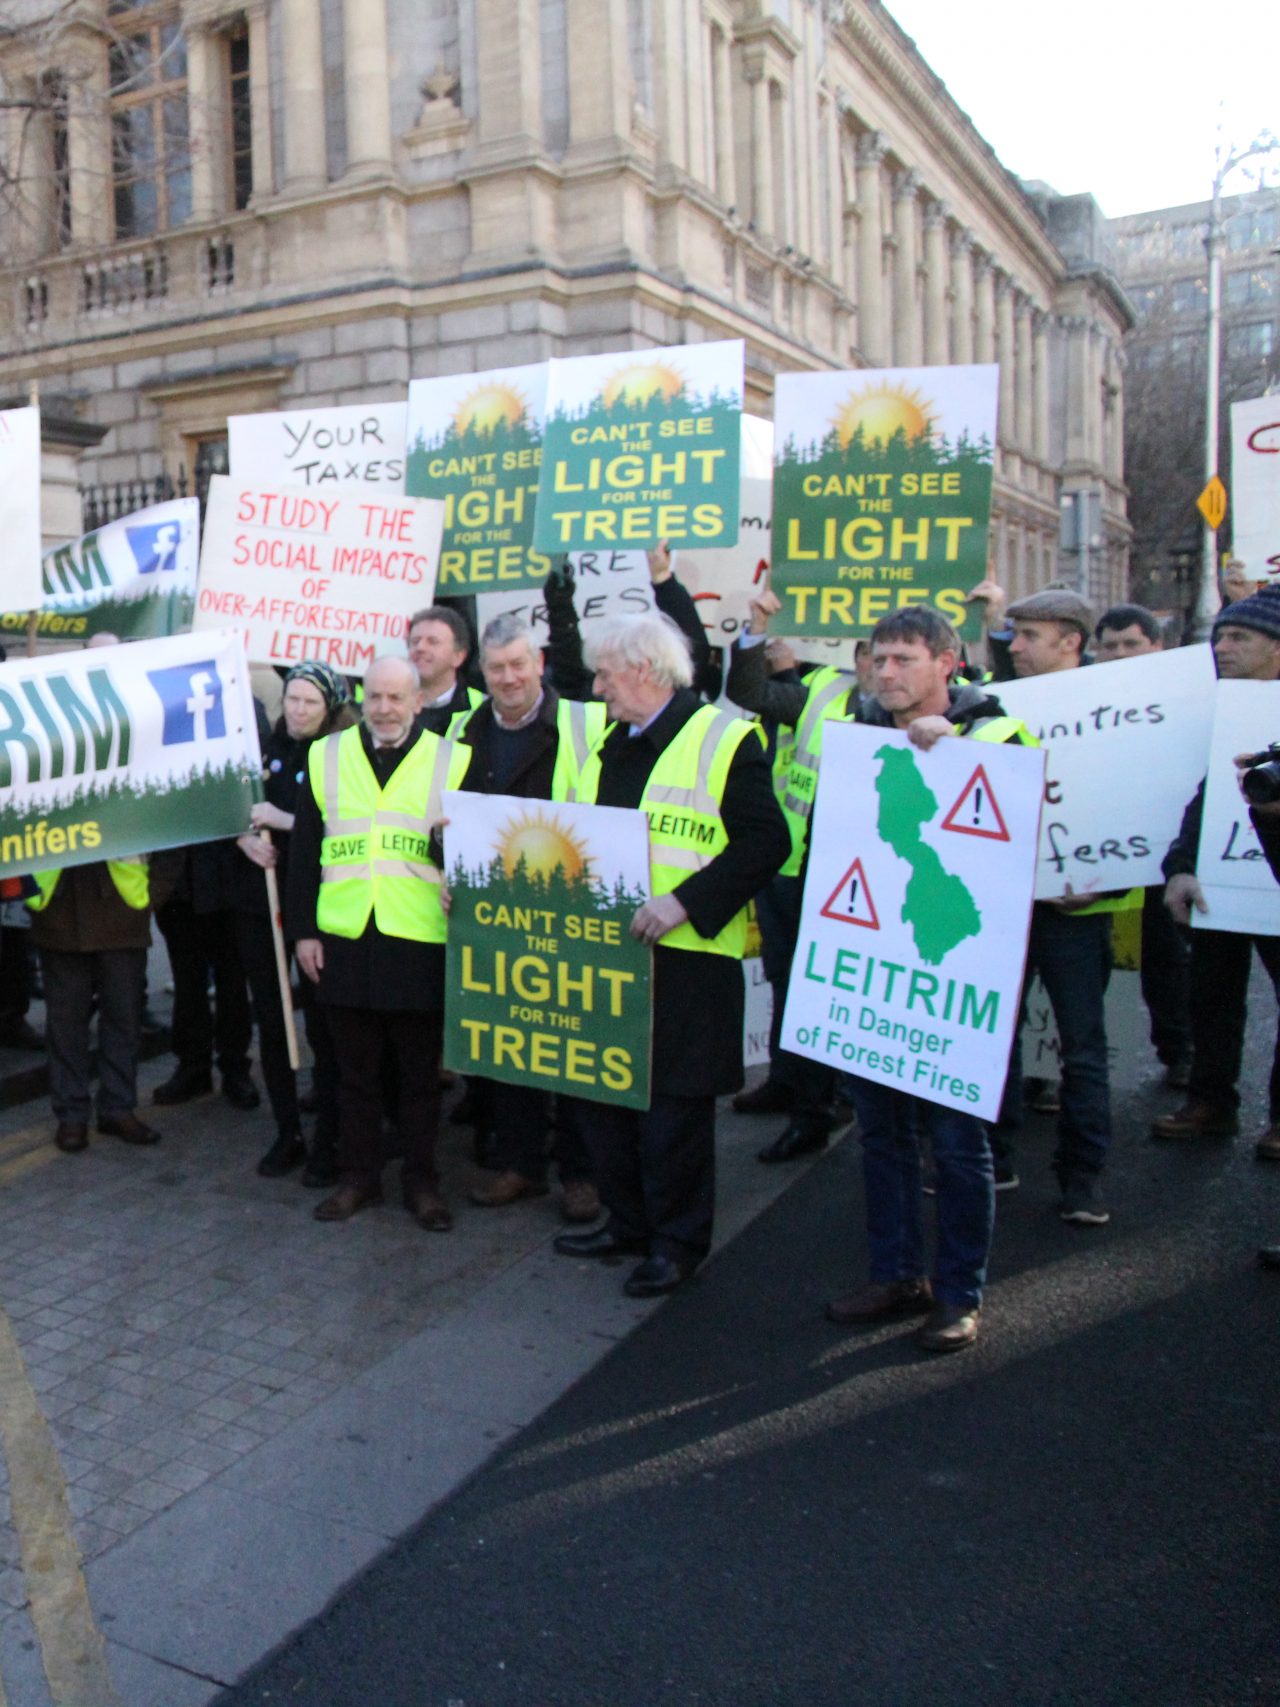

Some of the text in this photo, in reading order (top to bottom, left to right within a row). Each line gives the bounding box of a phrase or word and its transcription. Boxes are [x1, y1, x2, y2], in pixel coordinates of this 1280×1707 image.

[282, 416, 385, 459] YOUR
[570, 416, 715, 445] CAN'T SEE
[622, 440, 653, 452] THE
[291, 459, 403, 487] TAXES
[428, 447, 544, 479] CAN'T SEE
[471, 473, 498, 487] THE
[553, 448, 727, 494] LIGHT
[601, 489, 673, 504] FOR THE
[801, 472, 962, 498] CAN'T SEE
[237, 491, 416, 543] STUDY THE
[443, 485, 541, 530] IGH
[551, 503, 725, 543] TREES
[857, 498, 893, 513] THE
[453, 528, 513, 545] FOR THE
[786, 516, 974, 561] LIGHT
[232, 534, 429, 585] SOCIAL IMPACTS
[837, 566, 914, 581] FOR THE
[300, 578, 331, 600] OF
[269, 629, 377, 672] LEITRIM
[329, 839, 366, 859] SAVE
[474, 901, 622, 946] CAN'T SEE
[525, 934, 559, 954] THE
[461, 944, 635, 1018] LIGHT
[803, 940, 1001, 1034] LEITRIM
[510, 1004, 582, 1032] FOR THE
[827, 997, 954, 1057] in Danger
[460, 1018, 634, 1092] TREES
[795, 1026, 823, 1047] of
[825, 1031, 906, 1080] Forest
[913, 1060, 981, 1103] Fires
